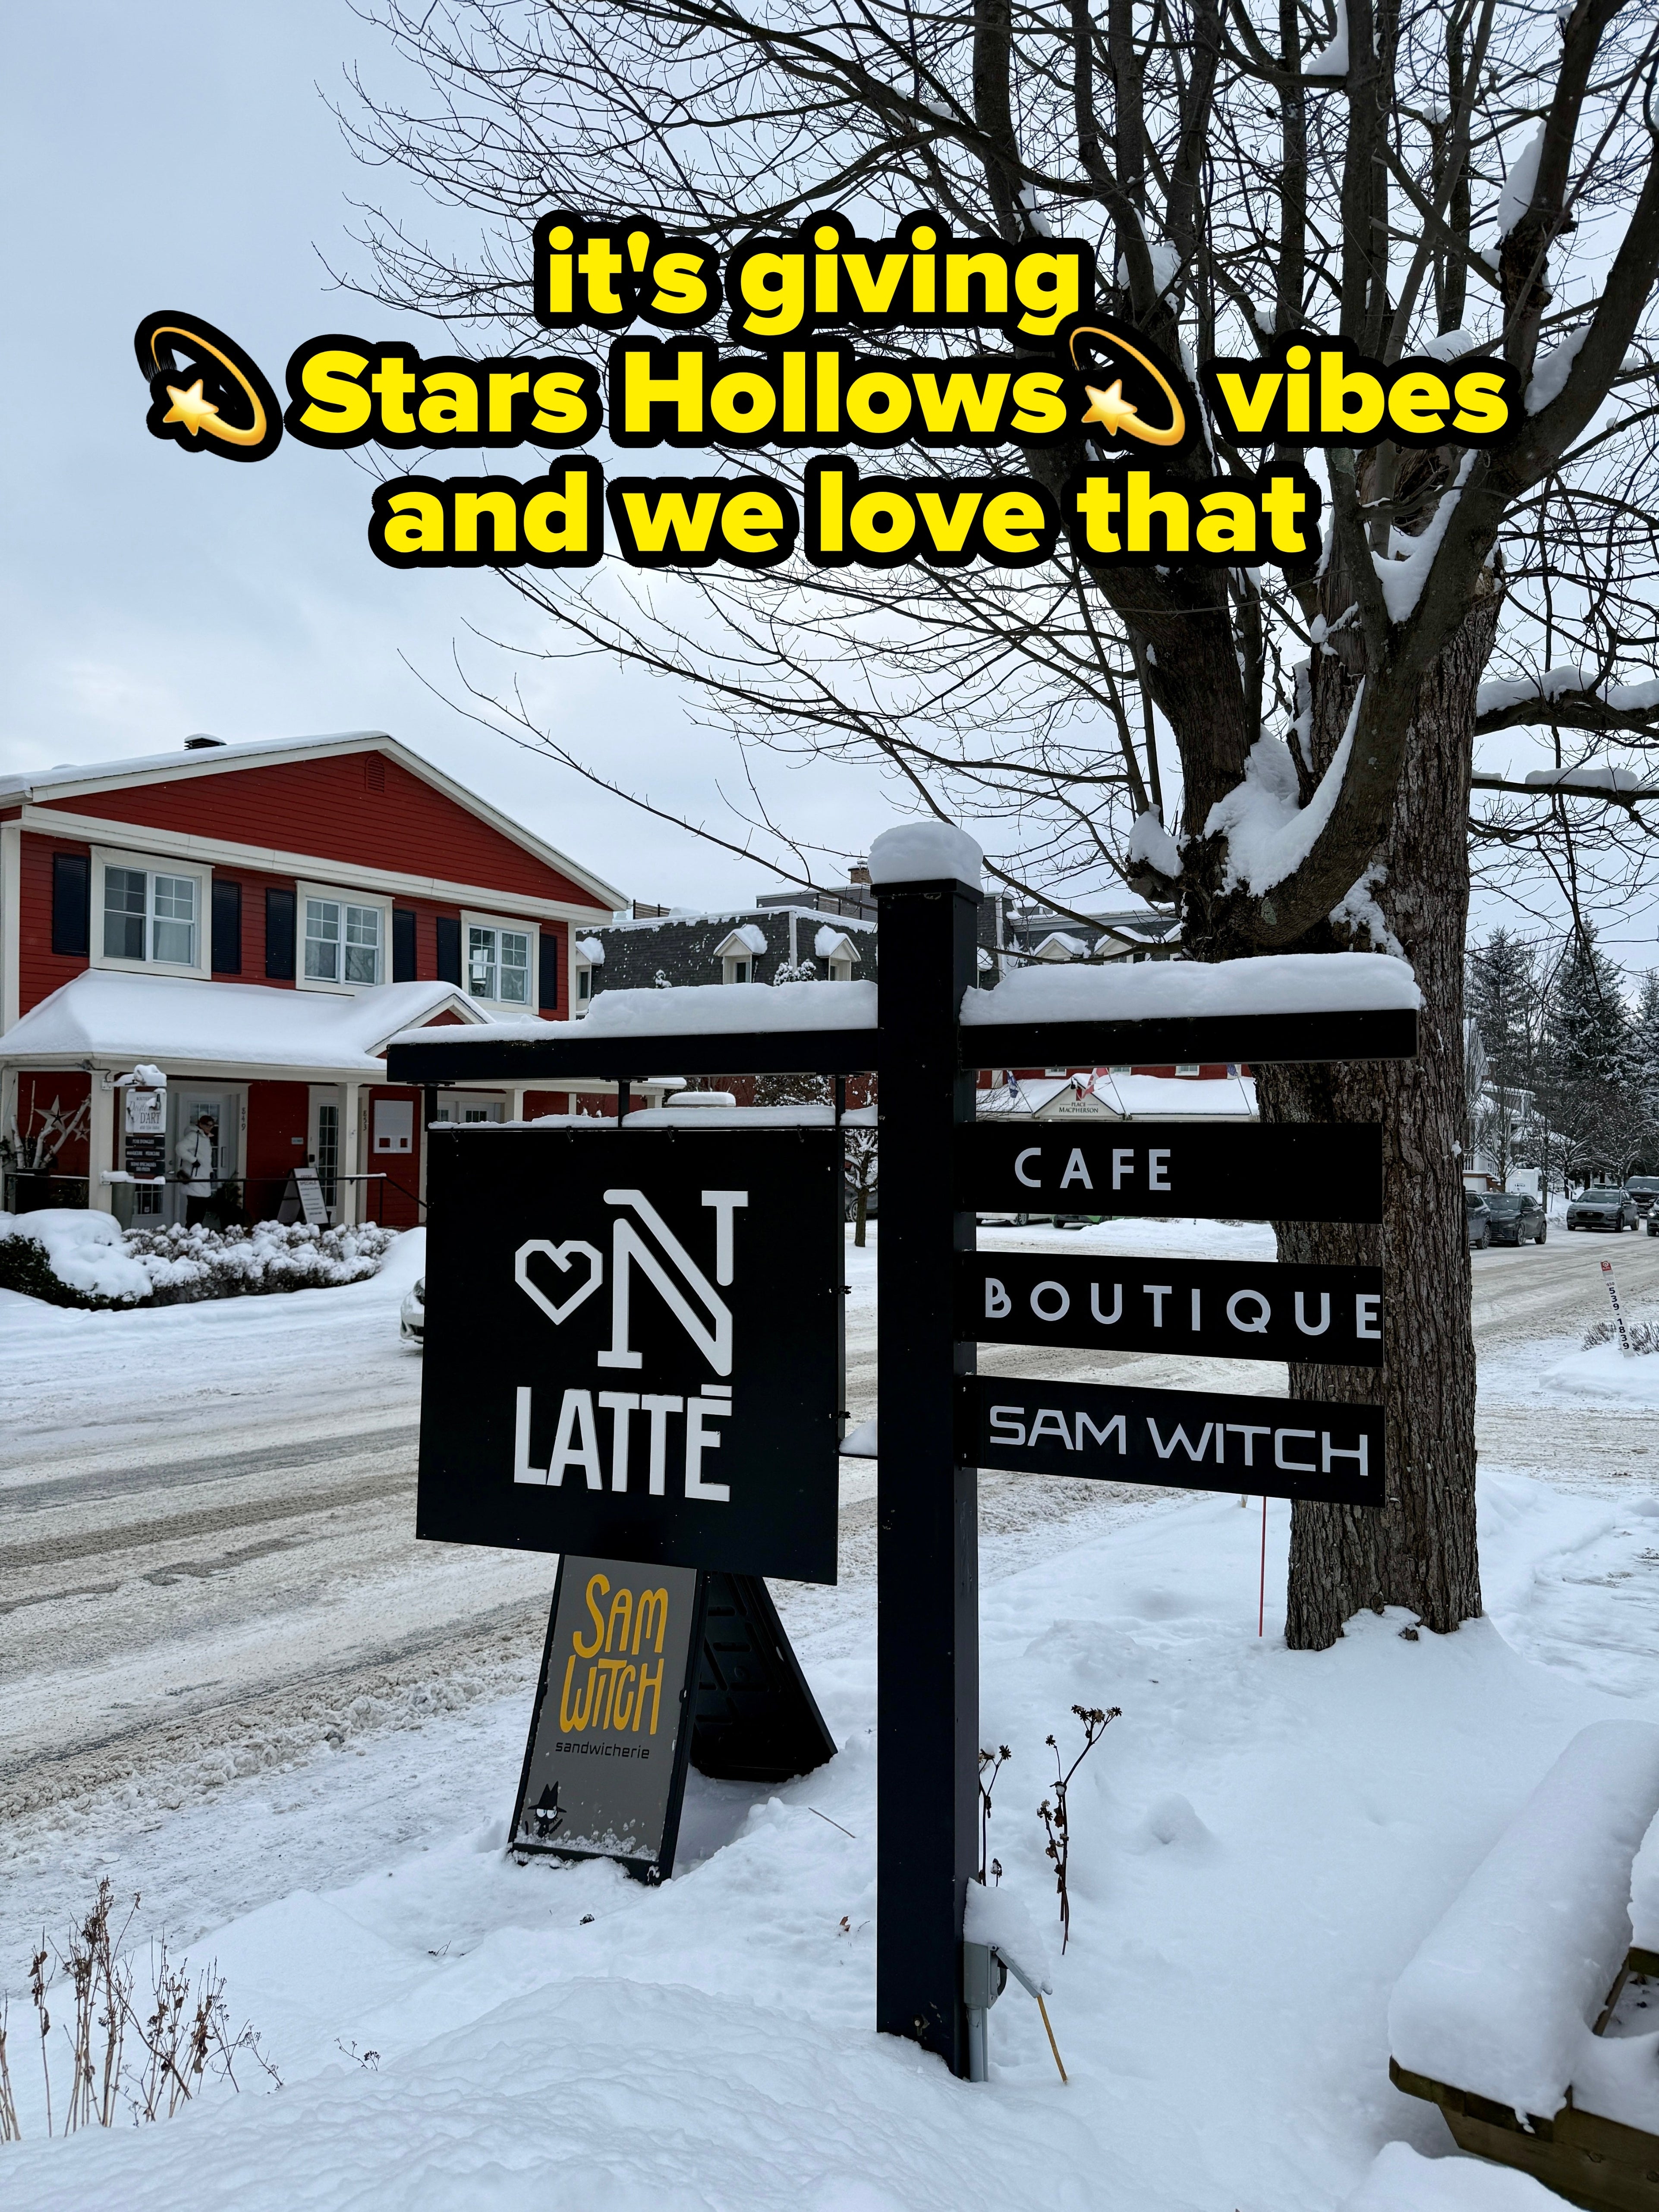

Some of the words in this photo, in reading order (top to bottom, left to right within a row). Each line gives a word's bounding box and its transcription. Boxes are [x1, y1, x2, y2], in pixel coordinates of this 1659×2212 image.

[1014, 1147, 1171, 1191] CAFE
[985, 1277, 1382, 1340] BOUTIQUE
[989, 1405, 1127, 1455] SAM
[1146, 1417, 1369, 1477] WITCH
[573, 1574, 669, 1658] SAM
[559, 1655, 664, 1735] WITCH
[555, 1740, 650, 1759] sandwicherie
